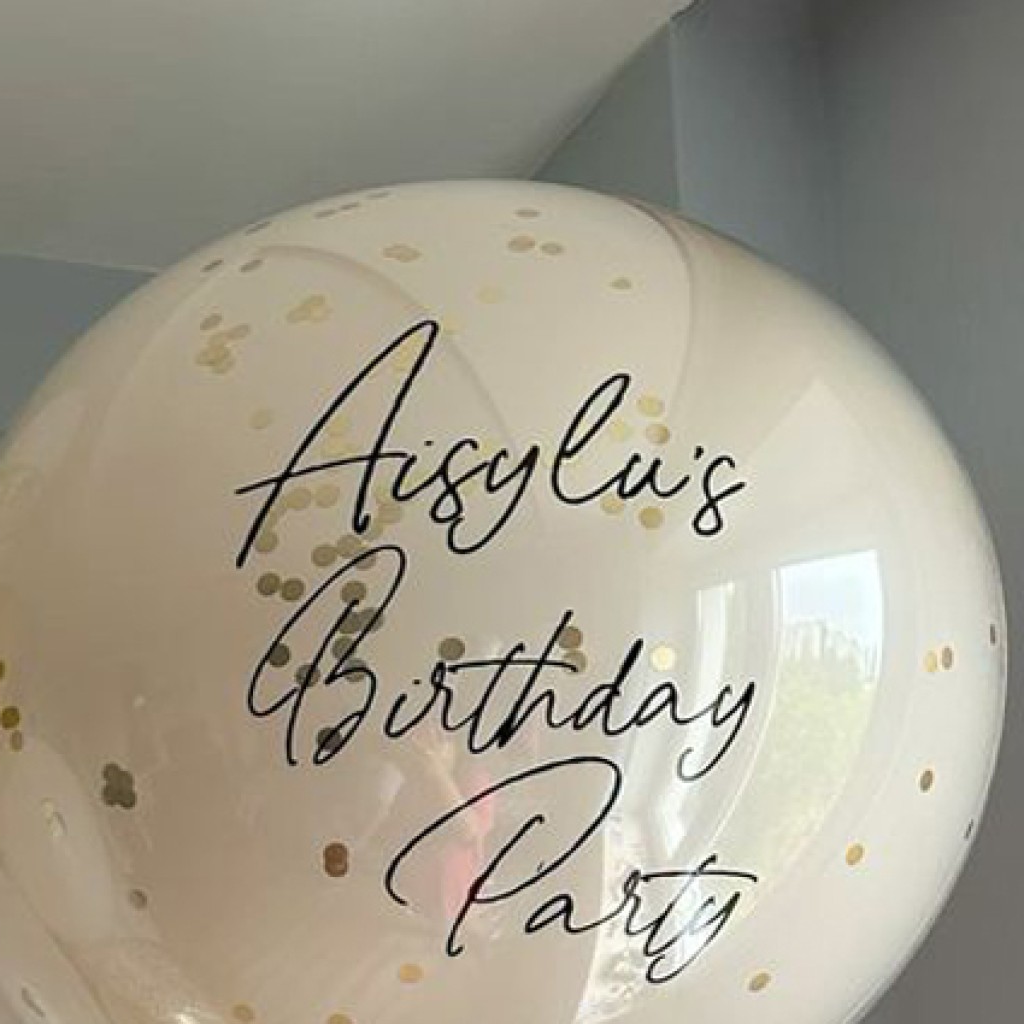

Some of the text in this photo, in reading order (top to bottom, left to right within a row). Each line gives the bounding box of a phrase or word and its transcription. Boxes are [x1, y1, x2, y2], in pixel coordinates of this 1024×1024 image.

[234, 319, 746, 569] Aisylu's
[246, 545, 756, 782] Birthday
[384, 755, 759, 984] Party
